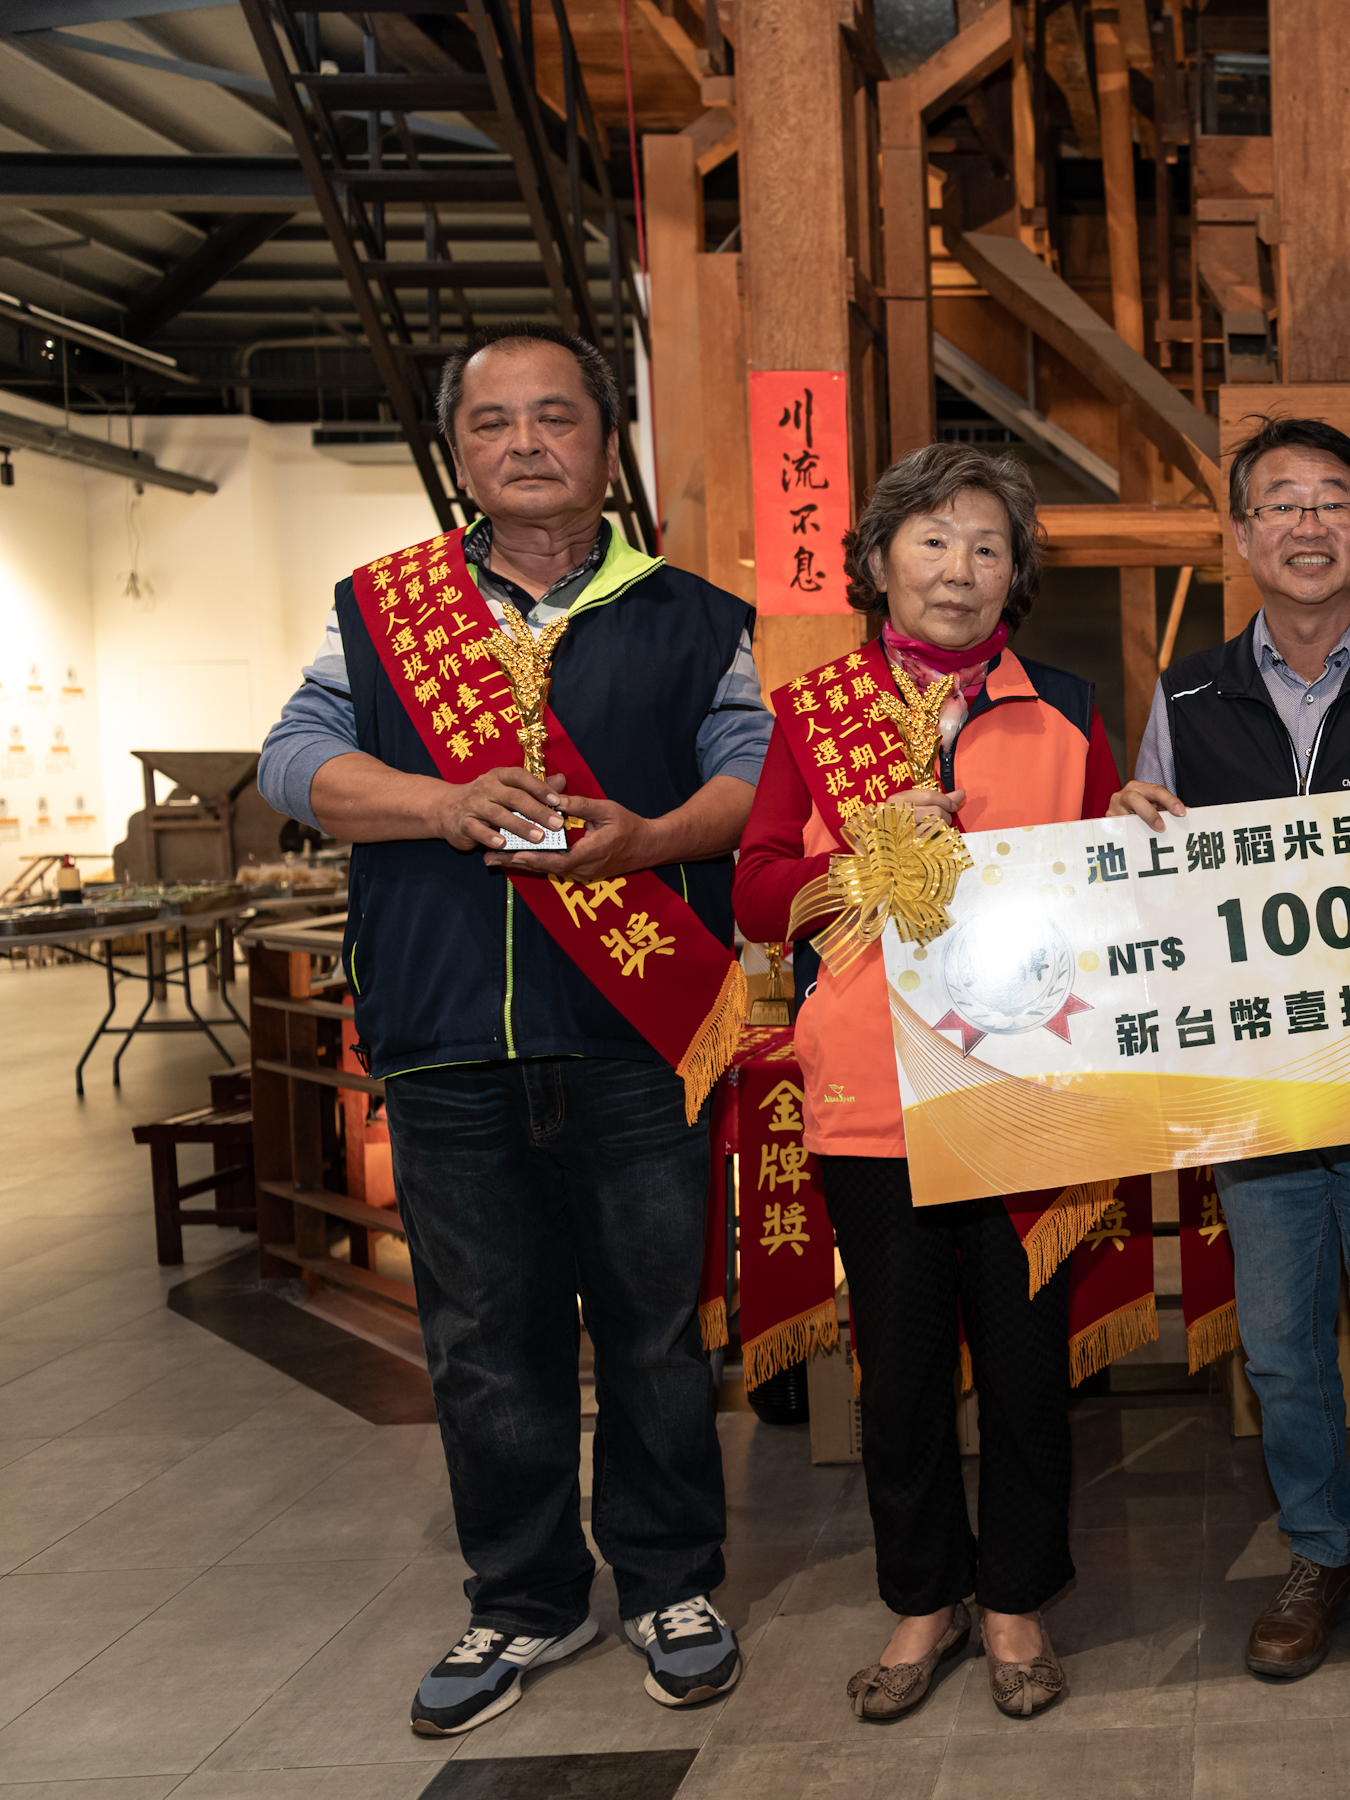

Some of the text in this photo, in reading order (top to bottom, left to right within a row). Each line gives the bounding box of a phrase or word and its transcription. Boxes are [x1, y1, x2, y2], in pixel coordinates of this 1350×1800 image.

[778, 388, 829, 593] 川流不息
[367, 556, 474, 763] 稻米達人選拔鄉鎮賽
[398, 545, 501, 745] 年度第二期作臺灣
[426, 534, 521, 724] 臺東縣池上鄉一一四
[816, 665, 890, 801] 度第二期作
[1109, 936, 1187, 976] NT$
[758, 1079, 811, 1256] 金牌獎
